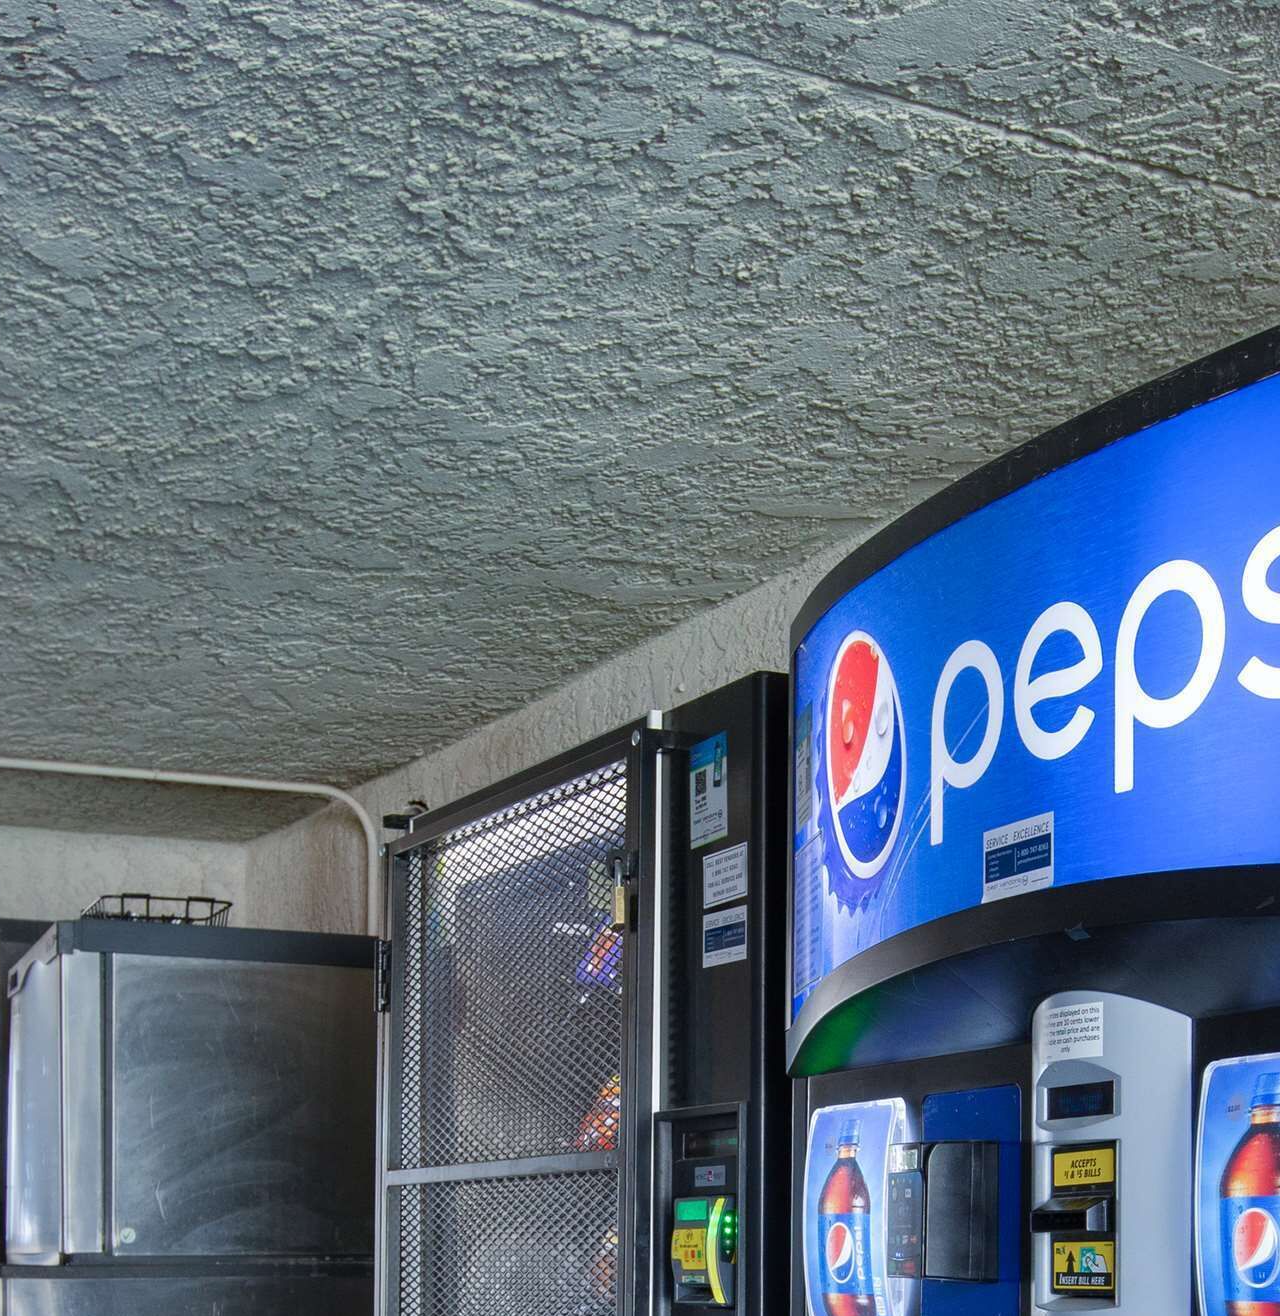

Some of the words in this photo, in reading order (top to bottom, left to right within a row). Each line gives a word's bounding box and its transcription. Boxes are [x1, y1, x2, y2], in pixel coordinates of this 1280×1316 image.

[986, 834, 1009, 850] SERVICE
[1013, 821, 1049, 842] EXCELLENCE
[1070, 1158, 1097, 1169] ACCEPTS
[1084, 1168, 1101, 1178] BILLS
[854, 1226, 865, 1280] pepsi
[1059, 1273, 1078, 1285] INSERT
[1078, 1276, 1090, 1285] BILL
[1091, 1276, 1105, 1286] HERE
